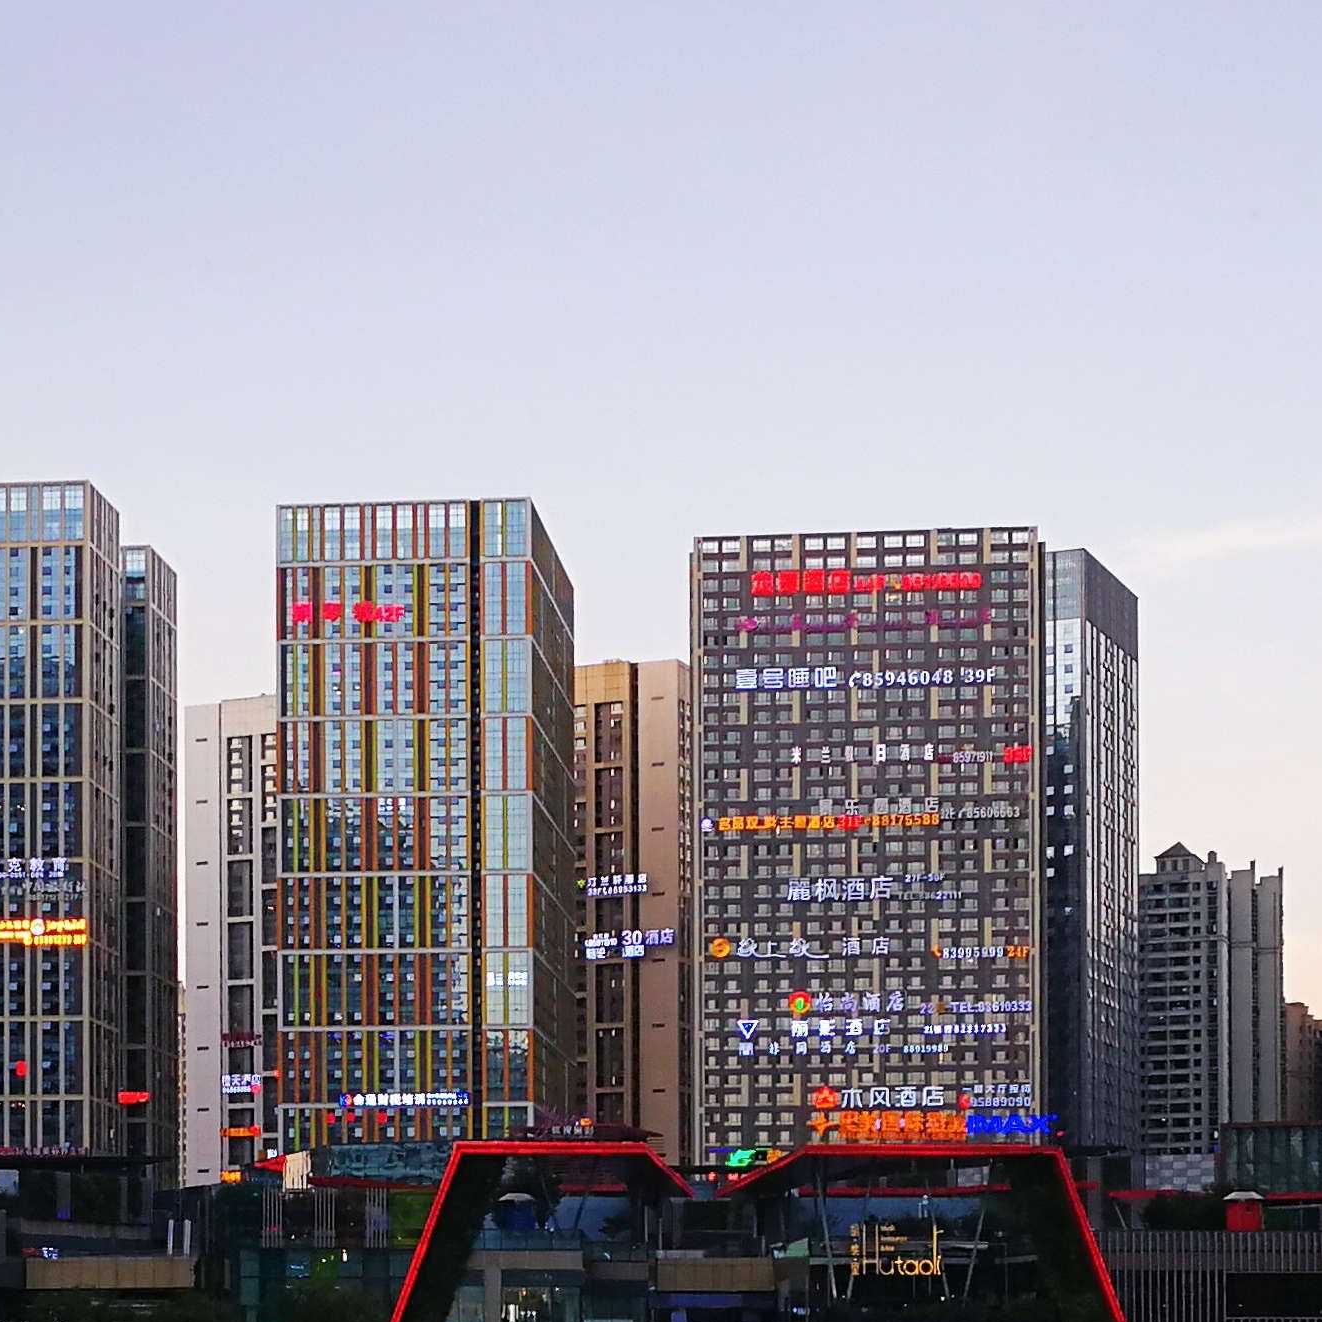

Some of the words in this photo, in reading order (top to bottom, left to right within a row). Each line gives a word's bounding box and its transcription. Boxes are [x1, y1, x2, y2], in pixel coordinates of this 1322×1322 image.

[736, 667, 837, 689] 壹号睡吧
[862, 670, 953, 686] 85946048
[790, 743, 934, 764] 米兰假日酒店
[787, 875, 894, 900] 麗枫酒店
[862, 1224, 943, 1276] Hutaoli
